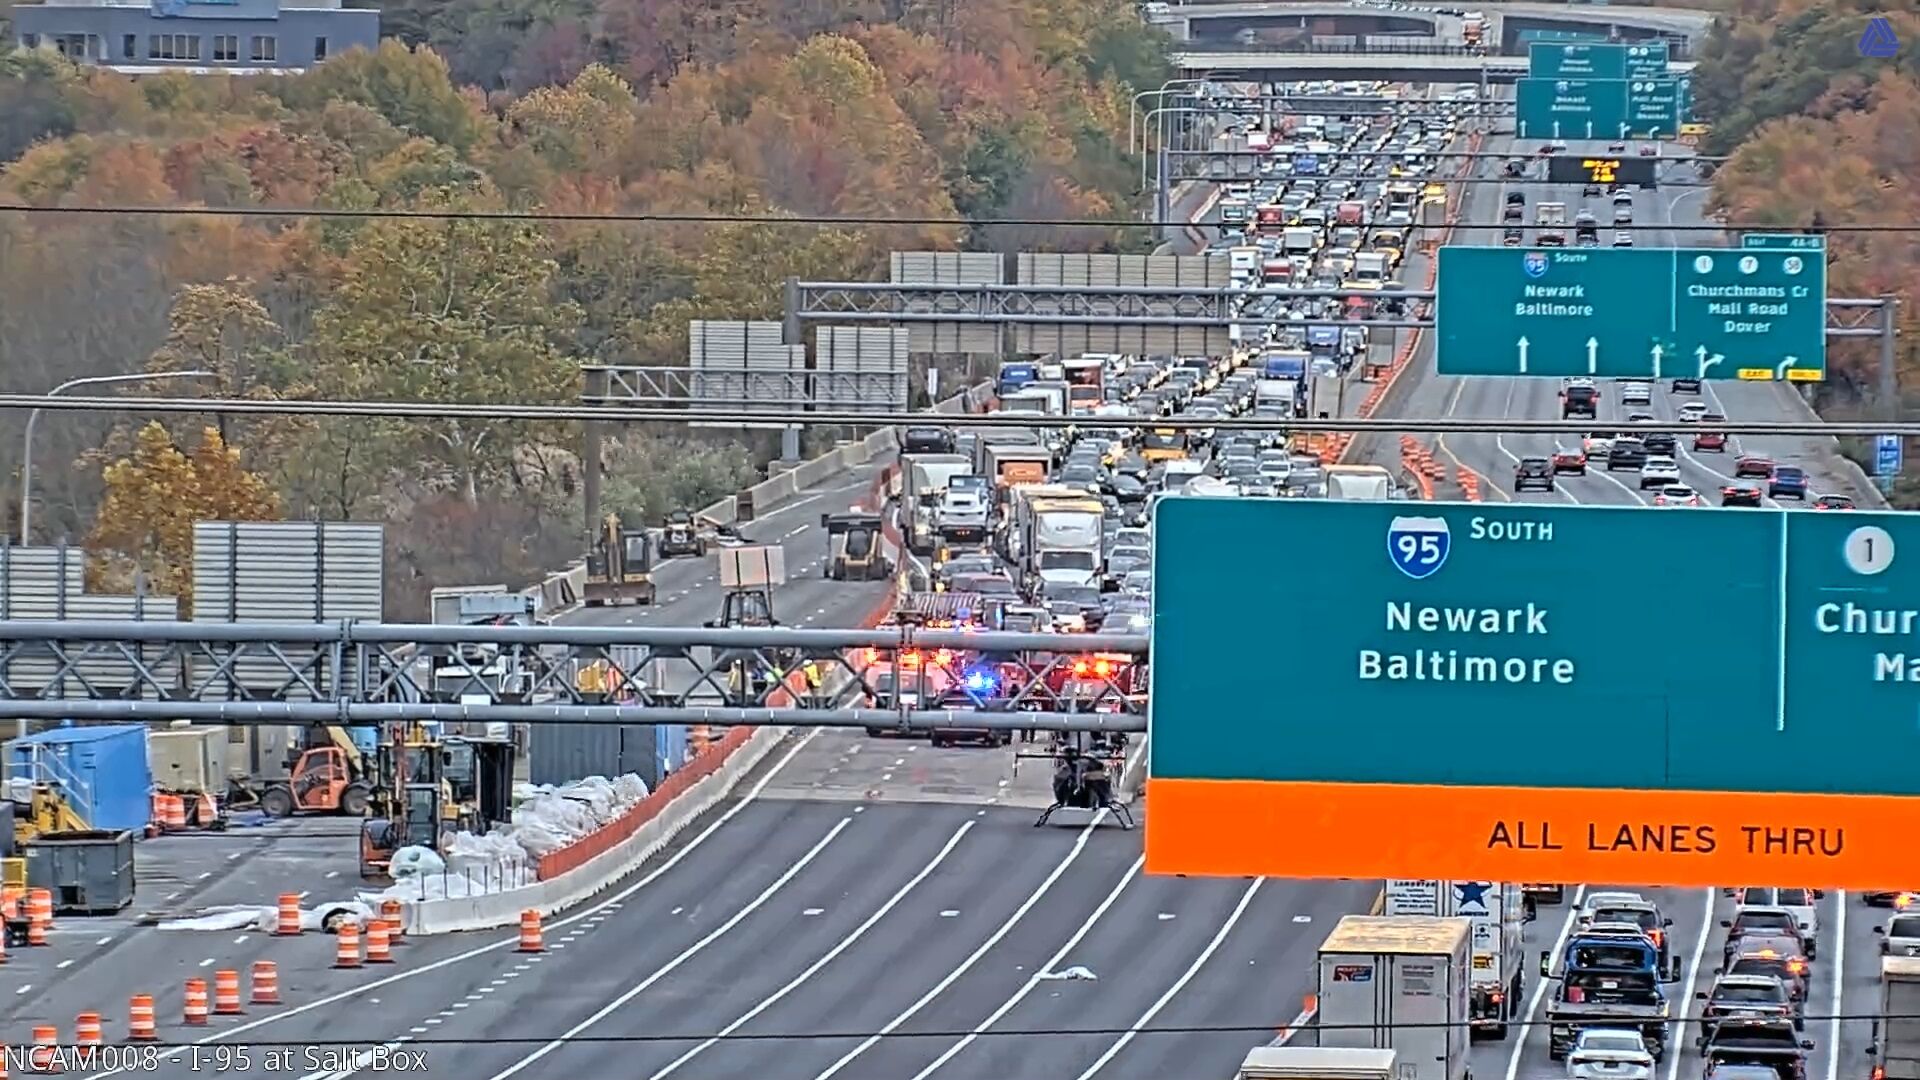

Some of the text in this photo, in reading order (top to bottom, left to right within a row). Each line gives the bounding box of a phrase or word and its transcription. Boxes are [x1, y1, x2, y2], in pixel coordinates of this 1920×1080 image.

[1527, 260, 1545, 273] 95
[1524, 284, 1585, 298] Newark
[1687, 284, 1810, 298] Churchmans Cr
[1514, 302, 1594, 316] Baltimore
[1707, 302, 1788, 315] Mall Road
[1723, 320, 1772, 333] Dover
[1470, 516, 1554, 542] SOUTH
[1398, 534, 1441, 565] 95
[1863, 537, 1874, 564] 1
[1386, 602, 1549, 635] Newark
[1815, 602, 1919, 635] Chur
[1358, 649, 1575, 685] Baltimore
[1487, 820, 1843, 857] ALL LANES THRU
